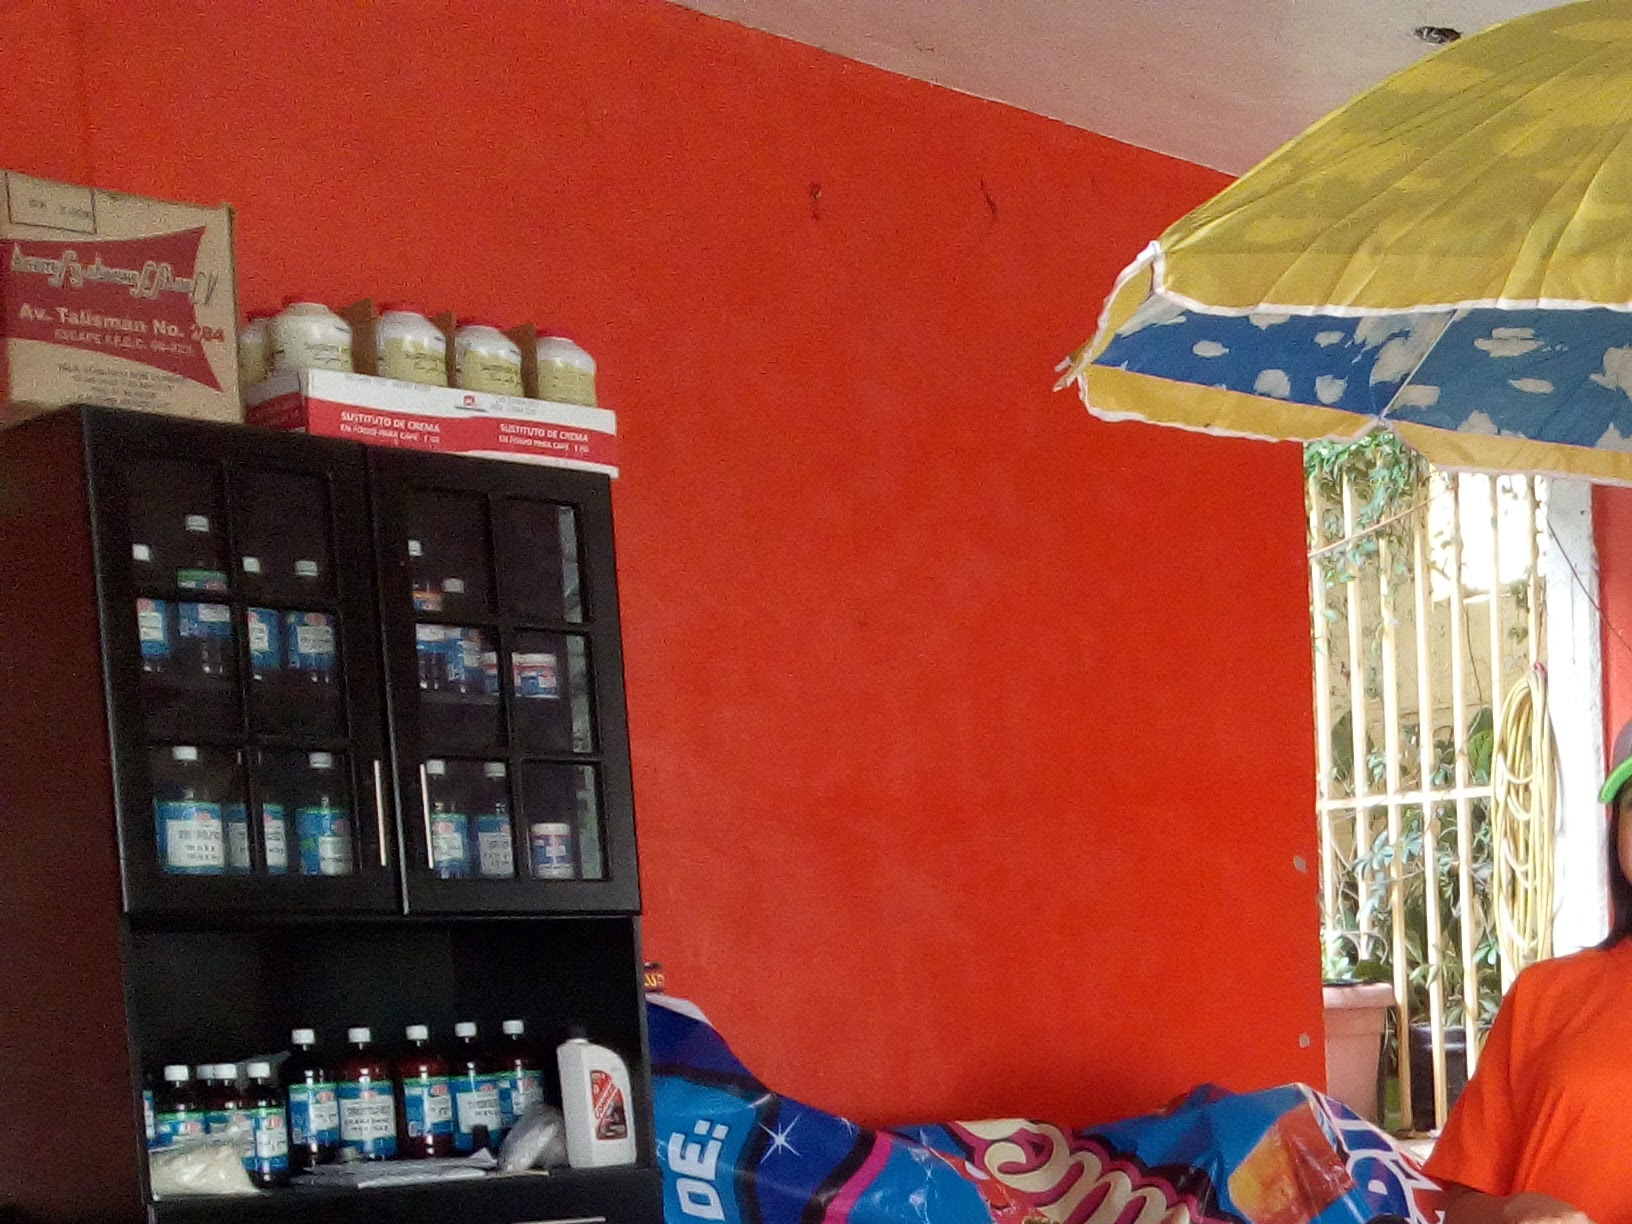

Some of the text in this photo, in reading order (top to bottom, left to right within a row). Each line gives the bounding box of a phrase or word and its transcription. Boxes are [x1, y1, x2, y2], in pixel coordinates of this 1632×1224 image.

[341, 411, 391, 427] SUSTITUTO
[407, 421, 440, 433] CREMA
[500, 423, 545, 437] SUSTITUTO
[559, 431, 589, 443] CREMA
[668, 1119, 730, 1222] DE:
